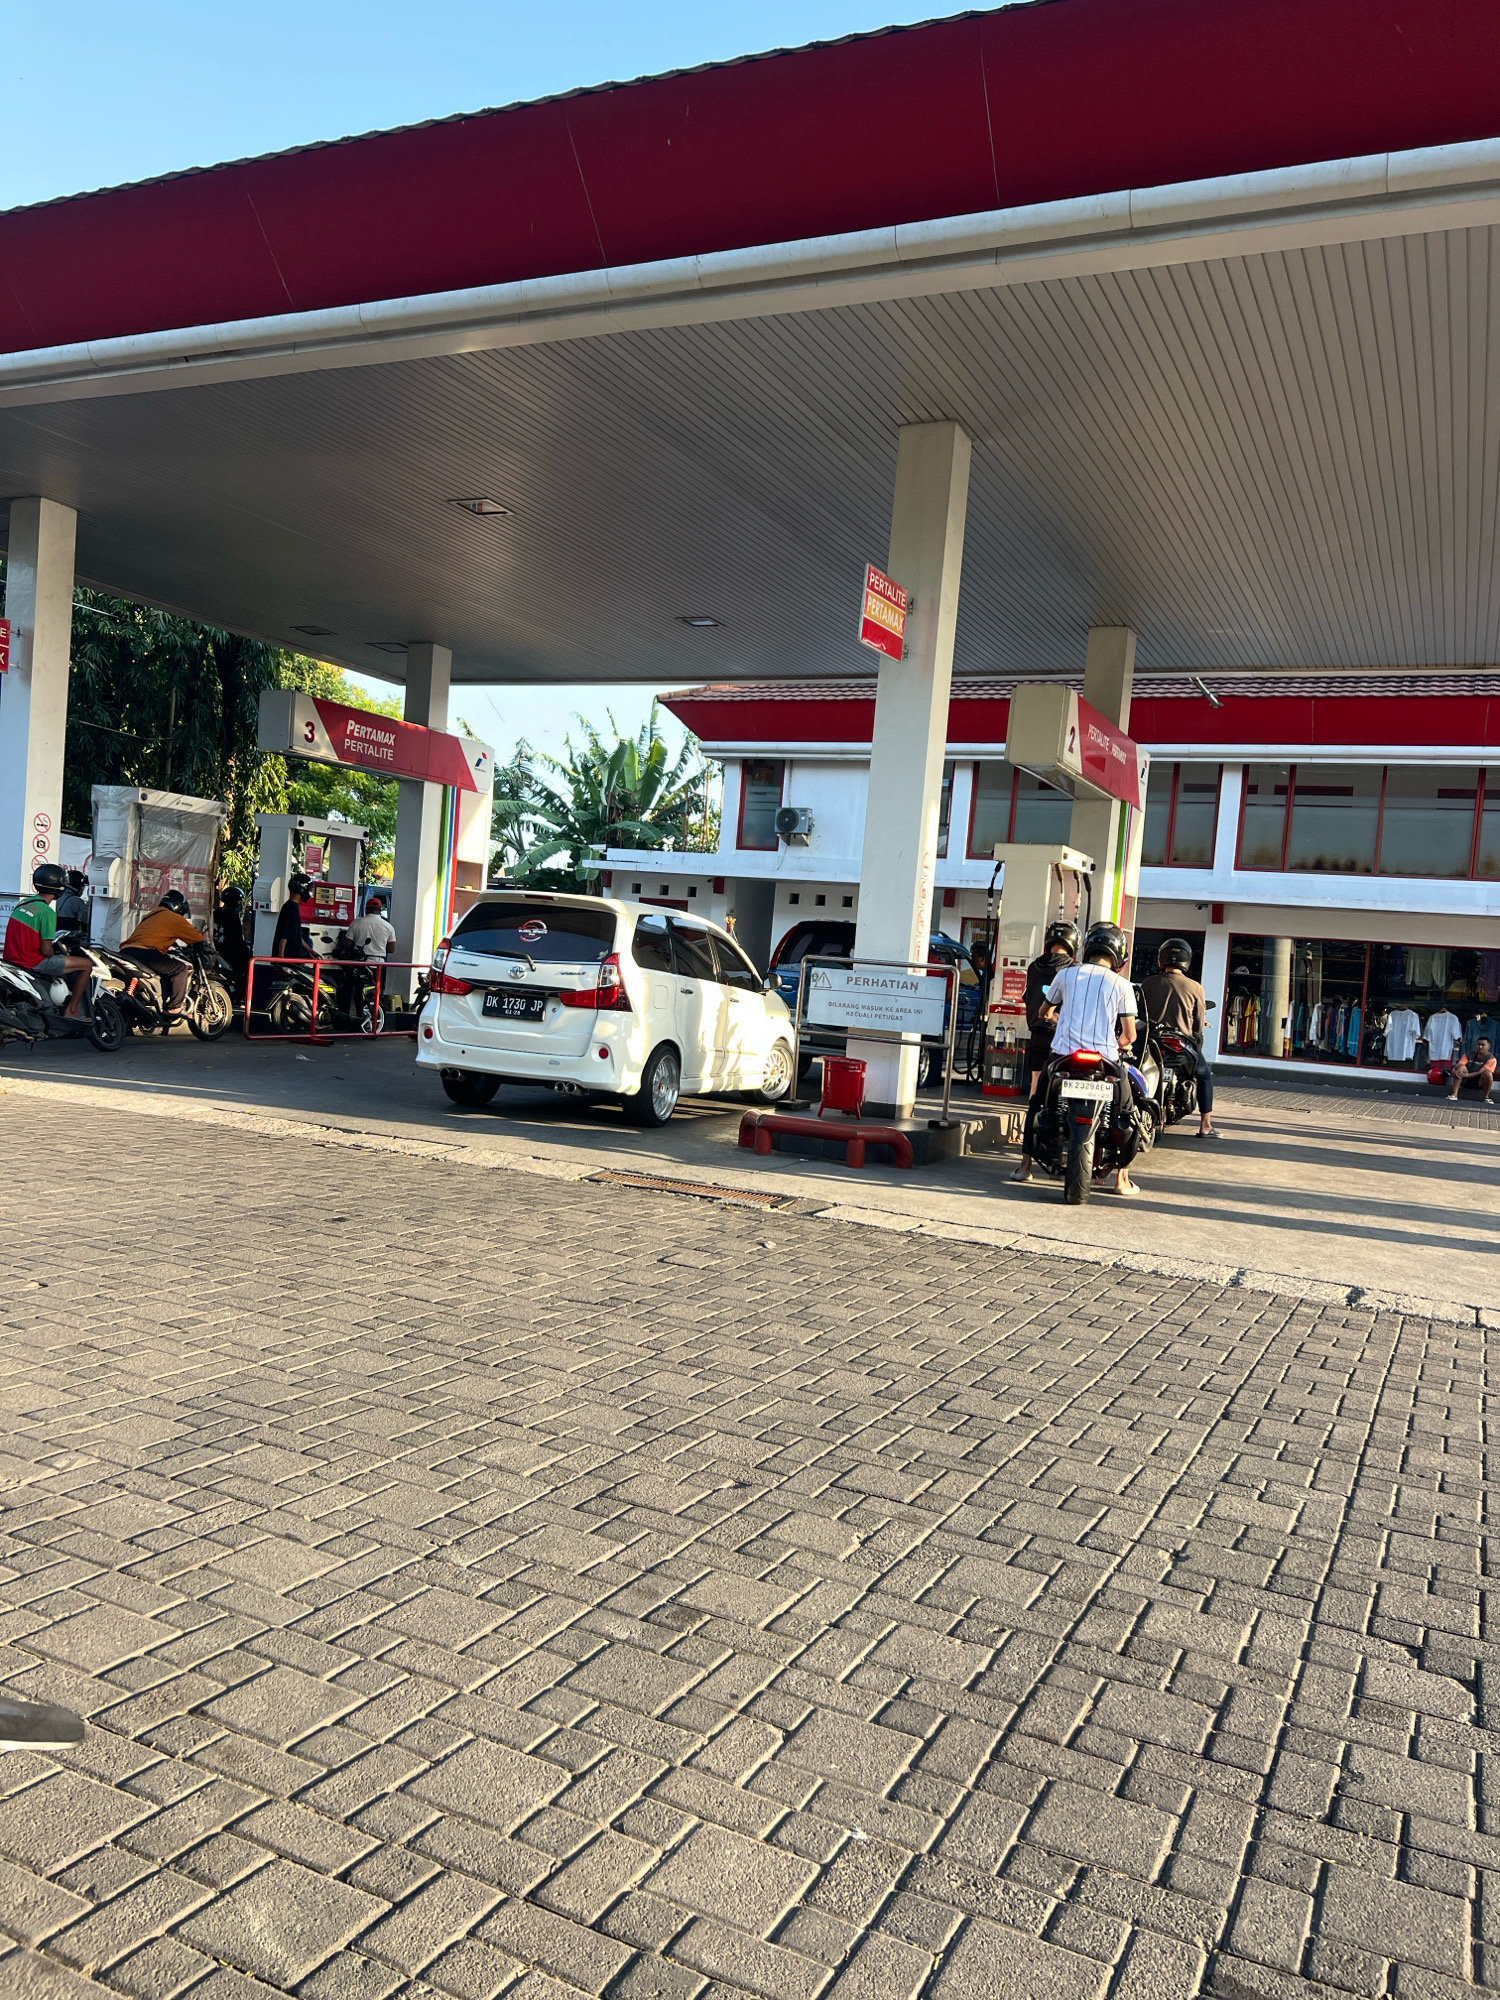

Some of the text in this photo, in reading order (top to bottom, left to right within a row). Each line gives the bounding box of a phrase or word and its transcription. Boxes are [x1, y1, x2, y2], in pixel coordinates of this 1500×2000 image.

[869, 571, 906, 608] PERTALITE
[867, 595, 904, 632] PERTAMAX
[304, 721, 316, 743] 3
[346, 719, 396, 746] PERTAMAX
[1067, 725, 1076, 755] 2
[1087, 723, 1110, 752] PERTALITE
[344, 738, 394, 761] PERTALITE
[846, 975, 919, 991] PERHATIAN
[486, 995, 544, 1012] DK 1730 JP
[828, 1001, 860, 1010] DILARANG
[861, 1003, 883, 1012] MASUK
[885, 1005, 894, 1013] KE
[895, 1006, 912, 1014] AREA
[845, 1011, 904, 1022] KECUALI PETUGAS
